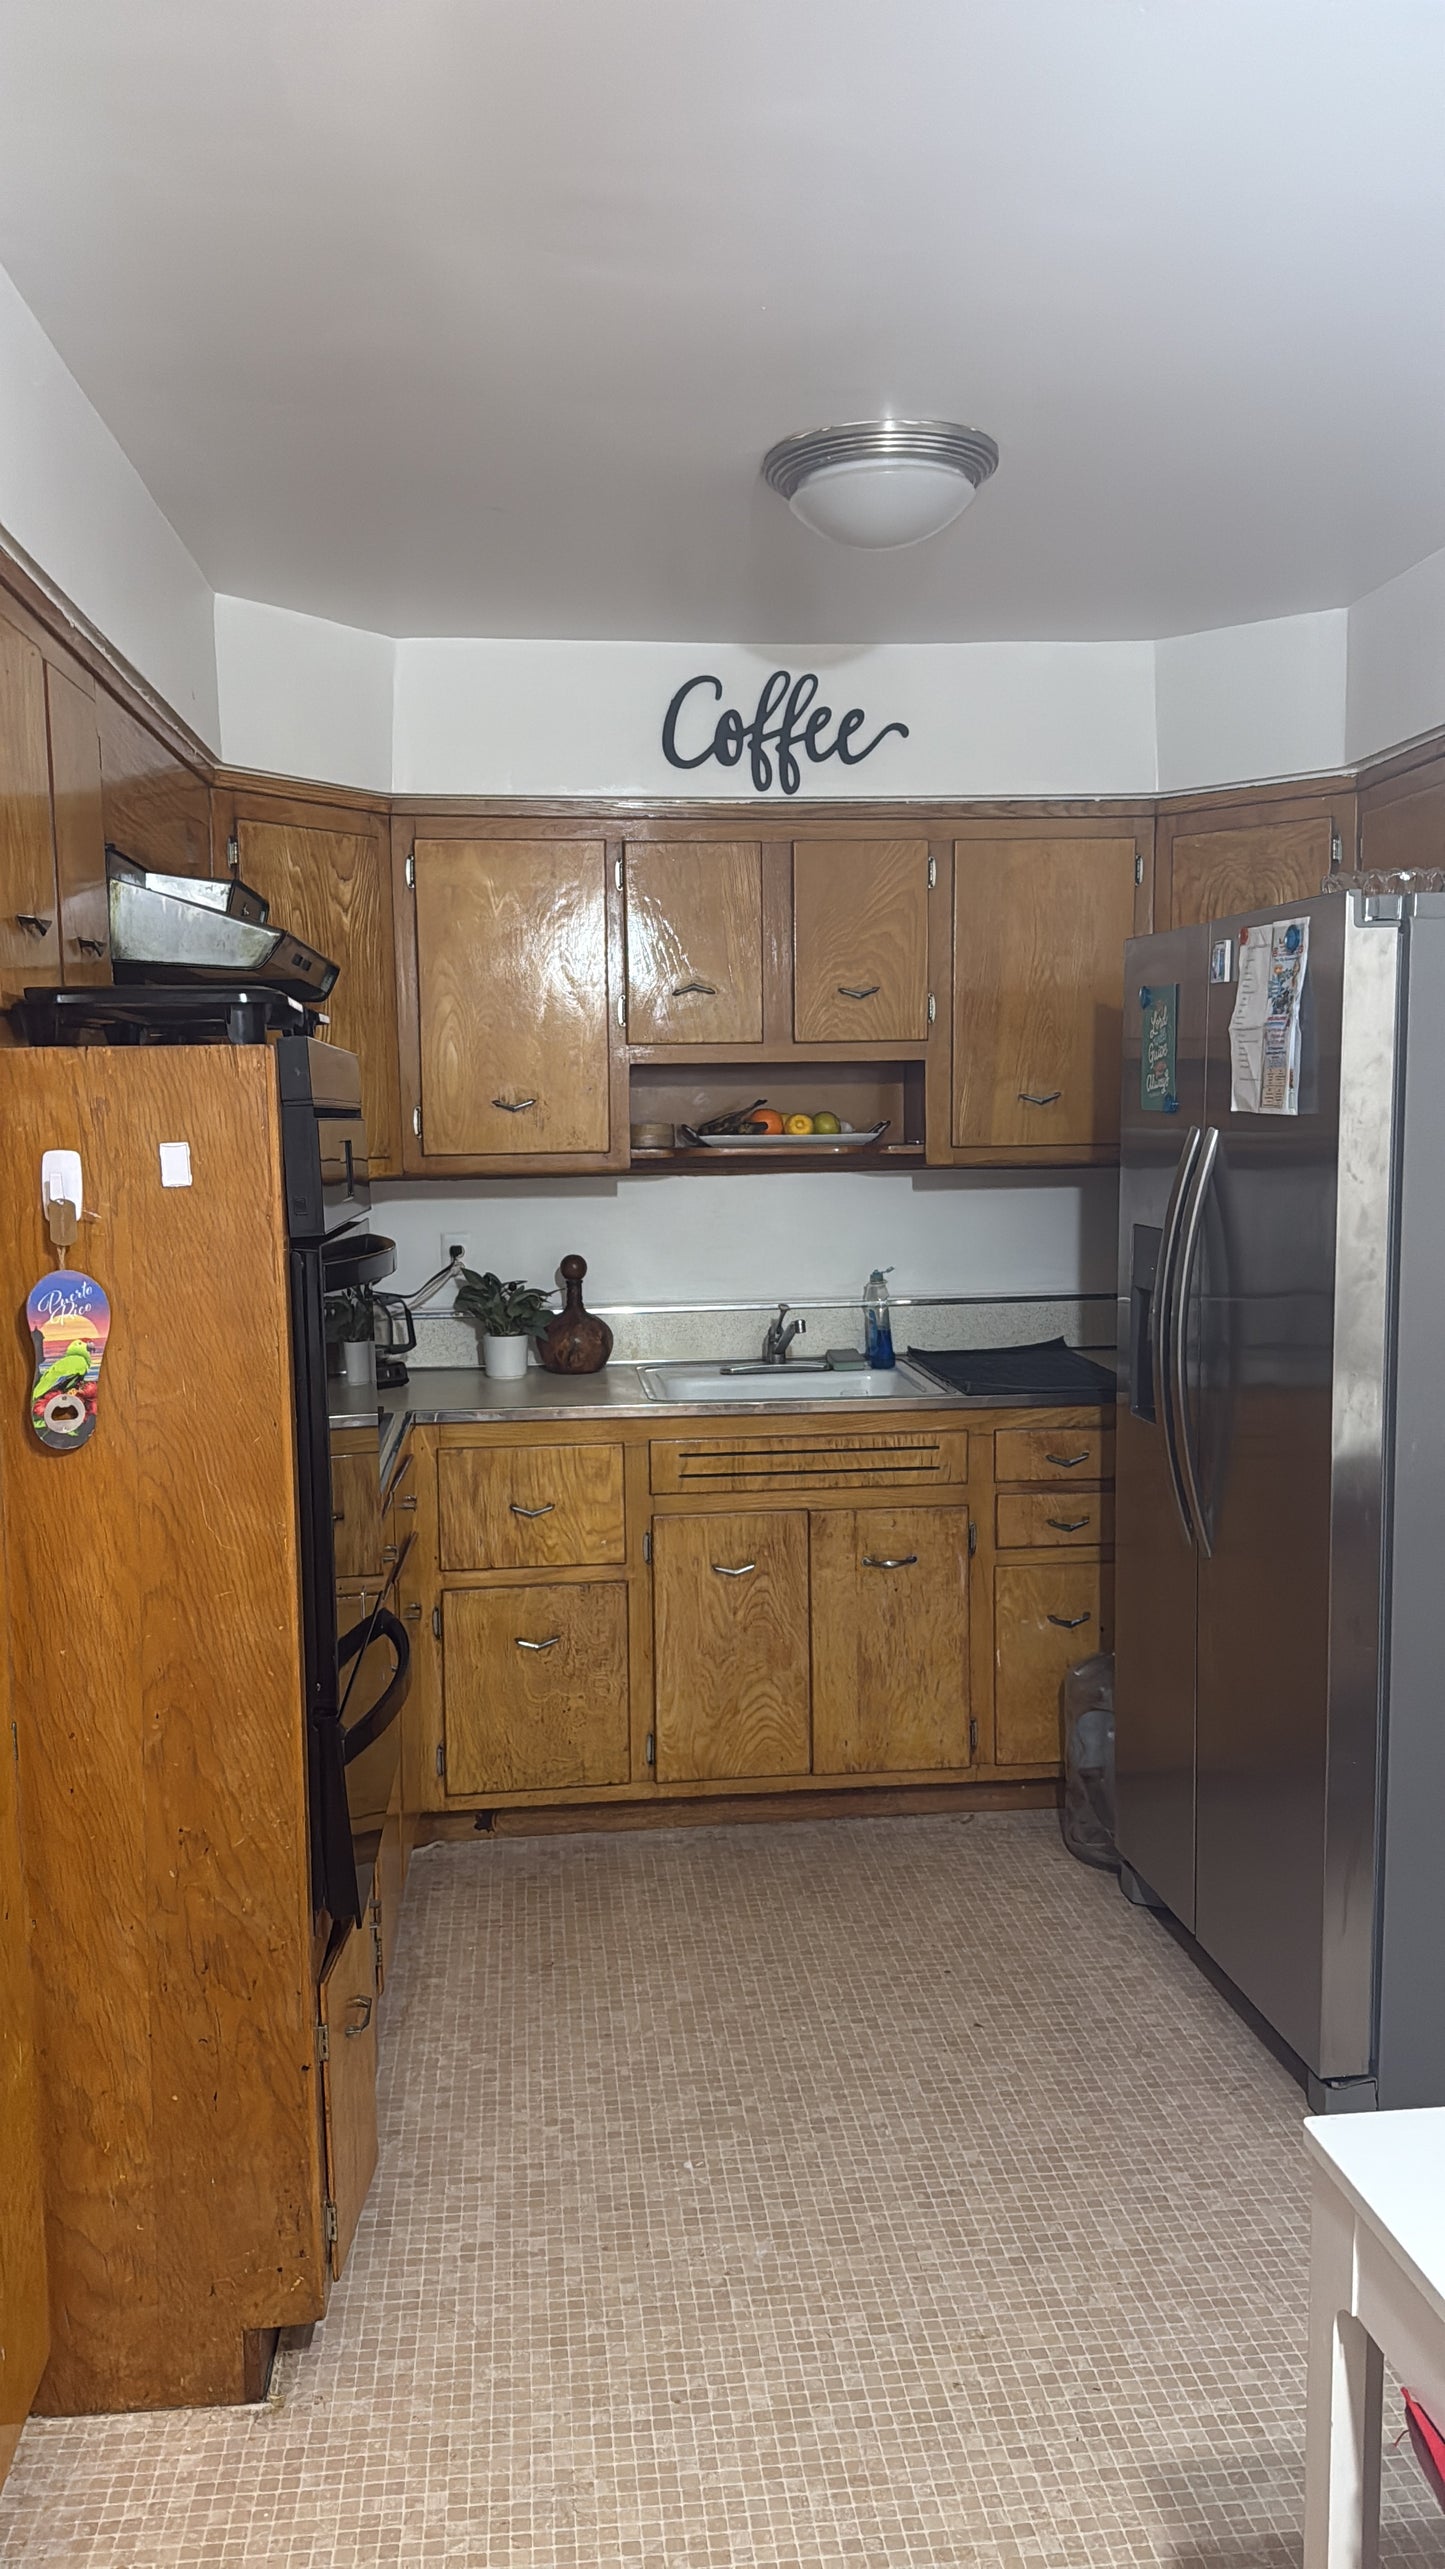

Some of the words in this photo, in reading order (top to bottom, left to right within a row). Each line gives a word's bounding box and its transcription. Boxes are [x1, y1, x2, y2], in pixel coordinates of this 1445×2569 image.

[662, 670, 909, 795] Coffee
[37, 1281, 93, 1315] Puerto
[50, 1301, 92, 1326] Rico
